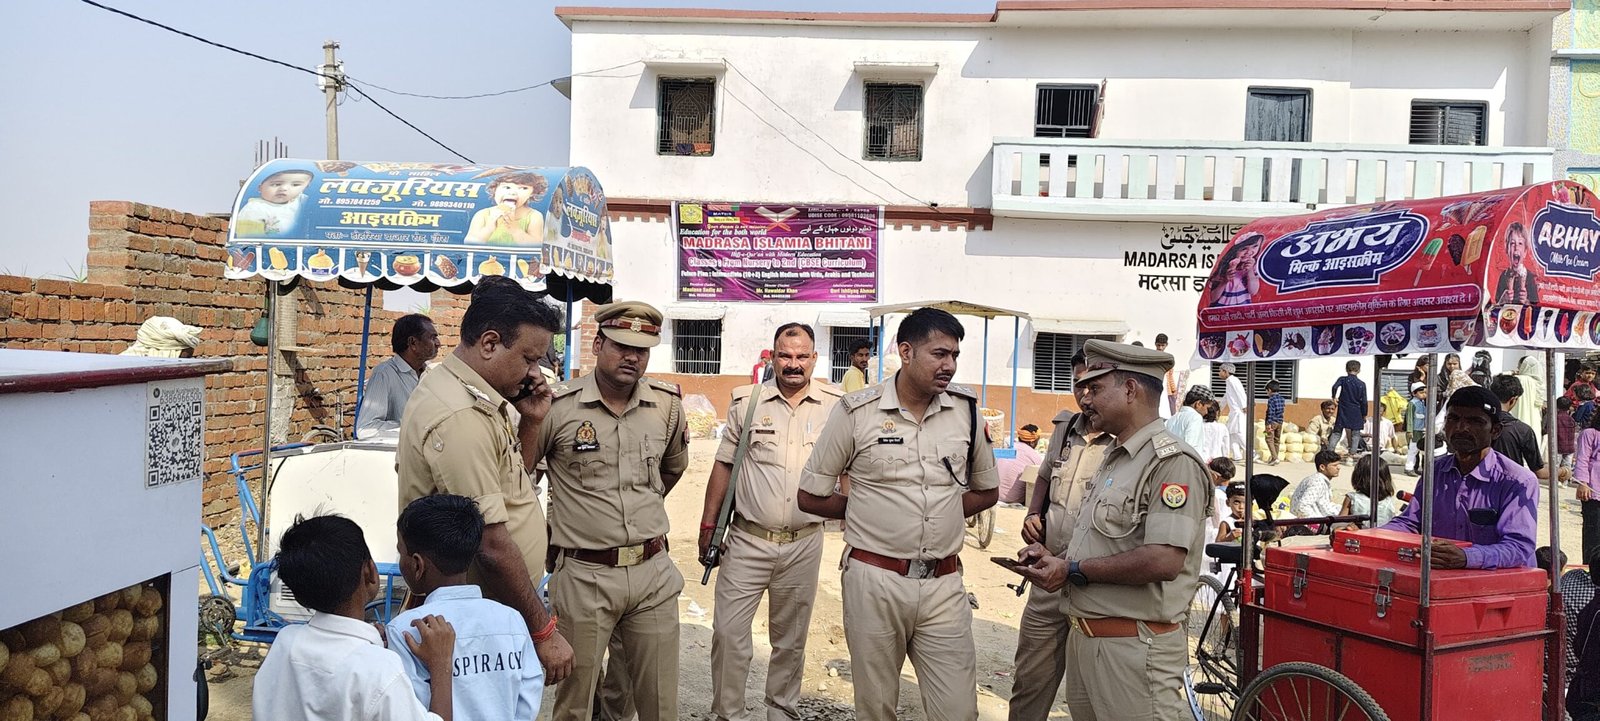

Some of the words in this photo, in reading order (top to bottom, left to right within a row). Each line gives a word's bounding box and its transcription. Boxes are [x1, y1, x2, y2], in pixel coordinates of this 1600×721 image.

[680, 228, 710, 236] Education
[710, 229, 721, 237] for
[1280, 219, 1411, 258] अभय
[1538, 221, 1600, 253] ABHAY
[682, 236, 752, 251] MADRASA
[753, 236, 813, 251] ISLAMIA
[814, 236, 872, 251] BHITANI
[688, 257, 717, 268] Classes
[722, 257, 742, 268] From
[742, 257, 772, 270] Nursery
[772, 258, 781, 268] to
[781, 257, 797, 268] 2nd
[797, 257, 821, 269] (CBSE
[821, 257, 866, 269] Curriculum)
[1124, 251, 1198, 269] MADARSA
[1201, 252, 1216, 269] IS
[1288, 258, 1322, 275] मिल्क
[761, 271, 779, 279] English
[1138, 274, 1191, 293] मदरसा
